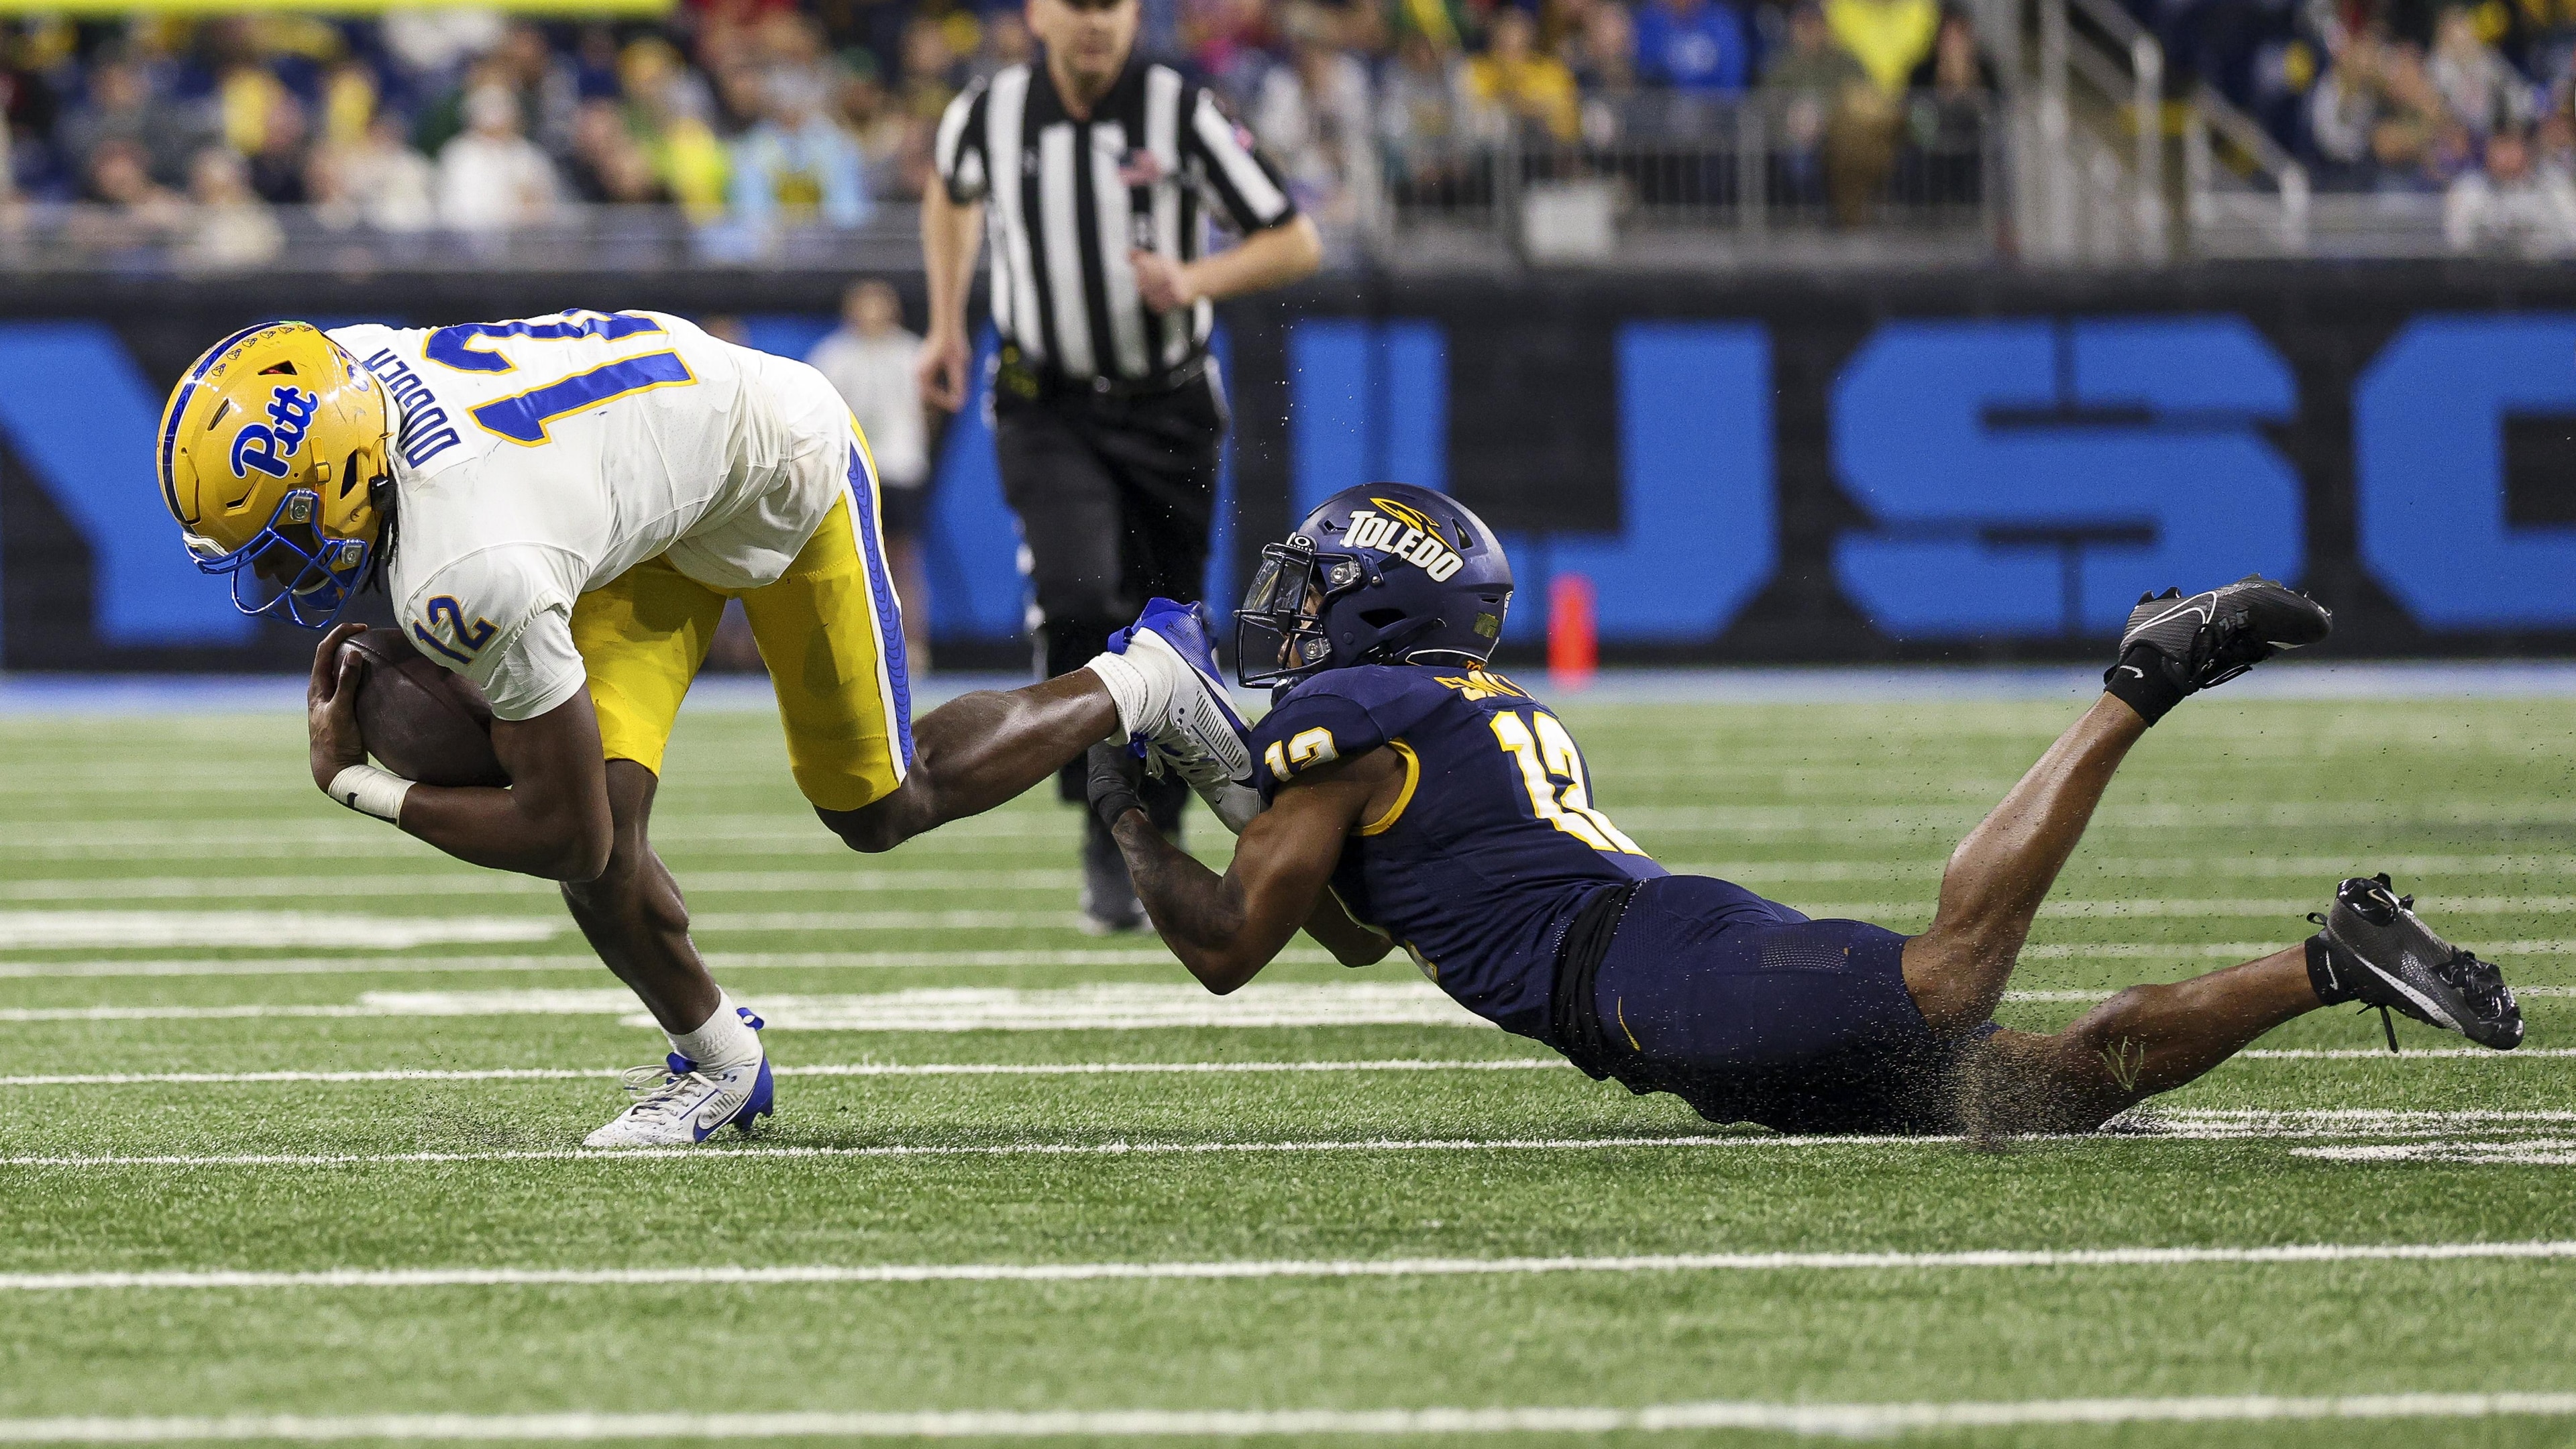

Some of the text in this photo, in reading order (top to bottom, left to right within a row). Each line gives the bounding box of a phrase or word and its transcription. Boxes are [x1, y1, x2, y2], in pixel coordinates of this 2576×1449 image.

[228, 384, 321, 479] Pitt
[1342, 510, 1464, 582] TOLEDO
[412, 594, 500, 665] 12
[1265, 726, 1340, 782] 12
[1489, 710, 1654, 860] 12
